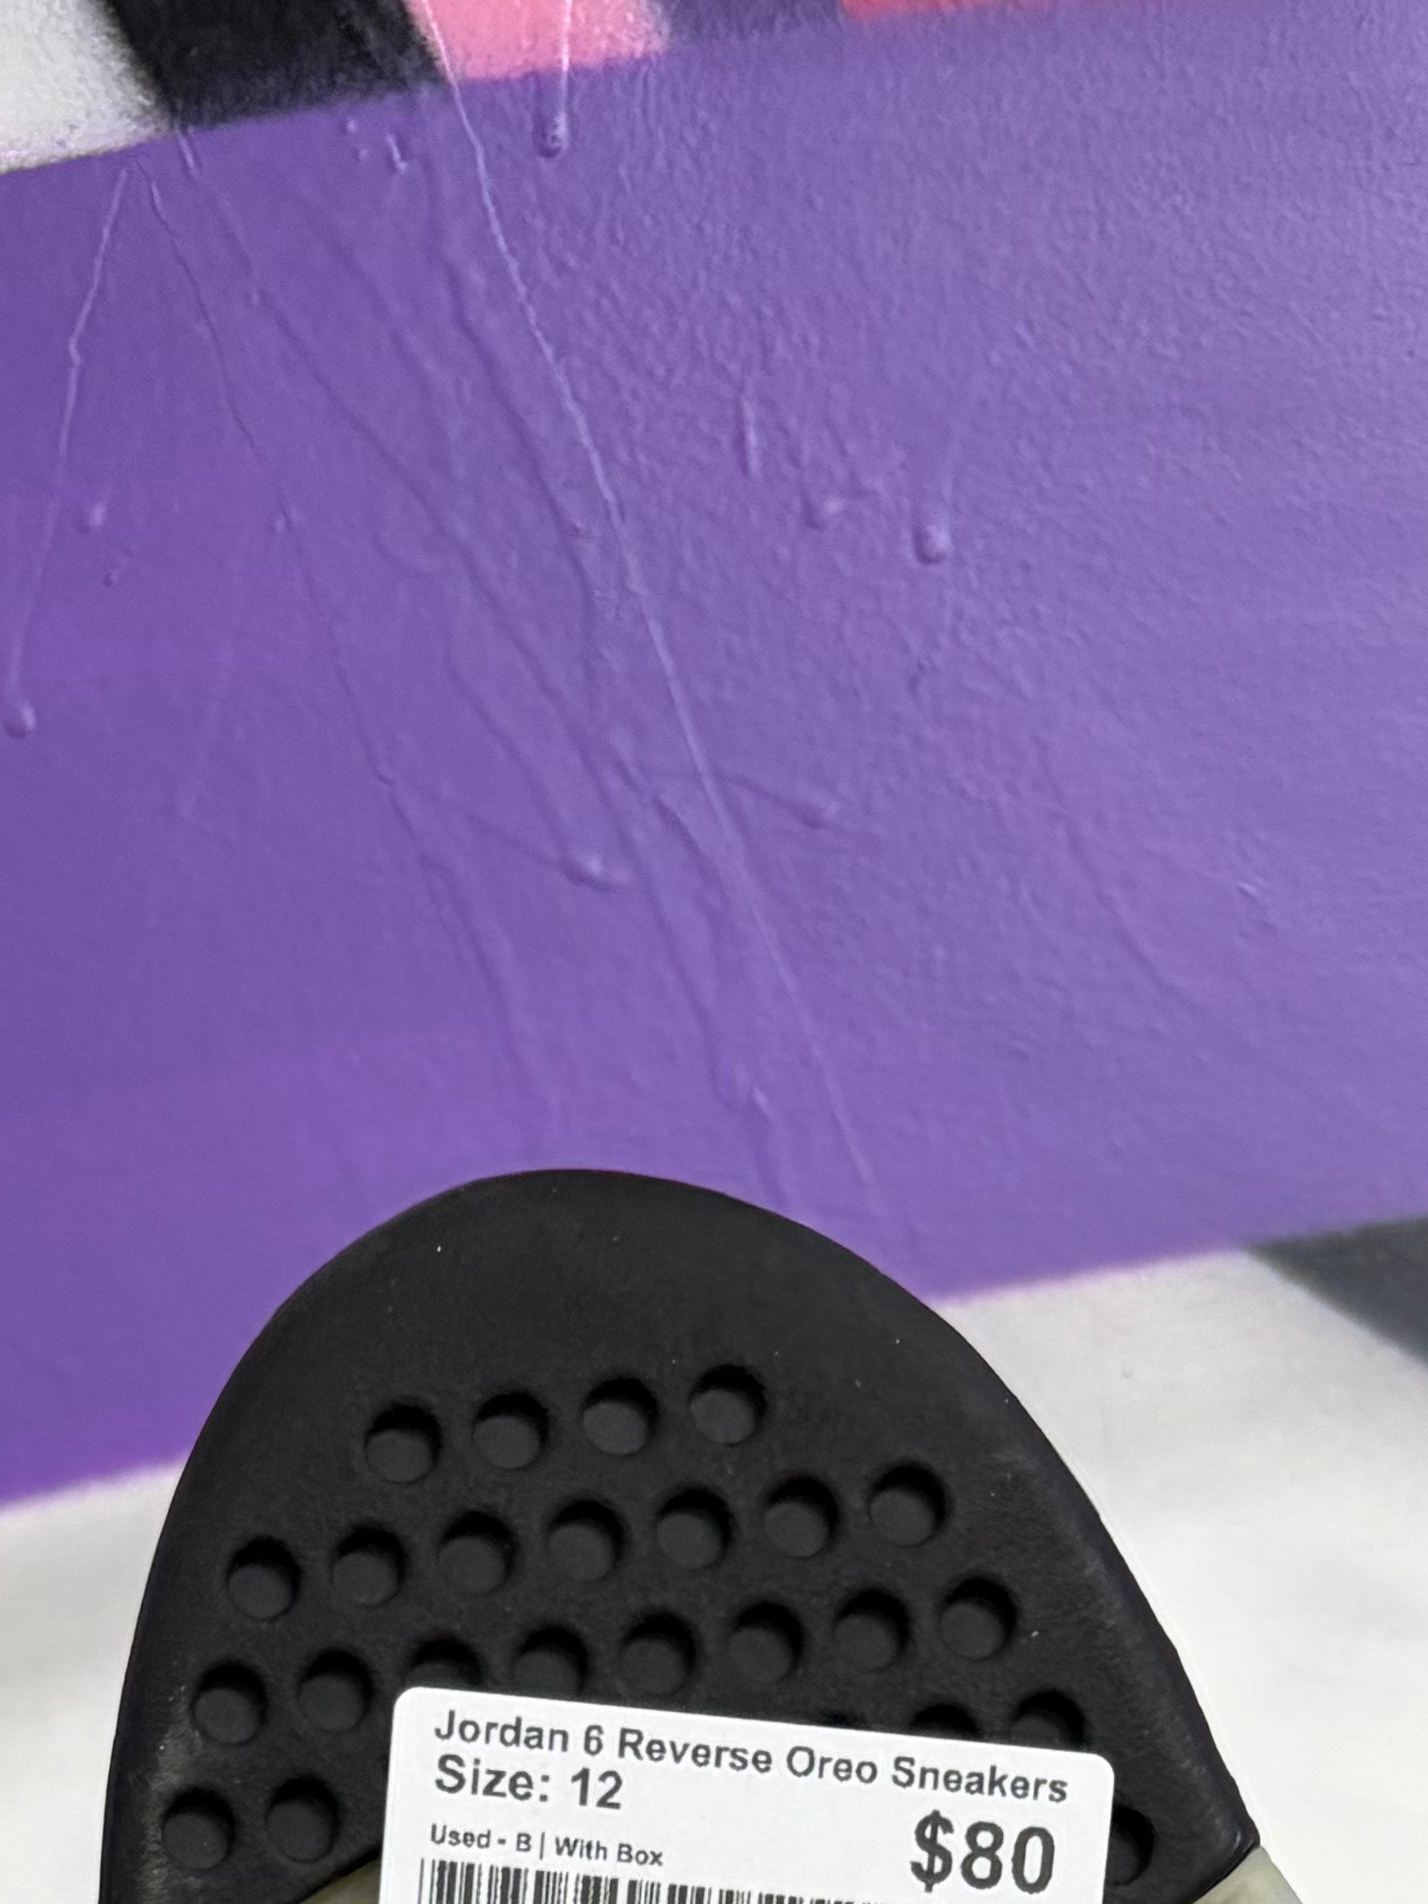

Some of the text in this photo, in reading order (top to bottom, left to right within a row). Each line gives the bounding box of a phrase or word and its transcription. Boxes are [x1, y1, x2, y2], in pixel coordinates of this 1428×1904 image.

[434, 1710, 1067, 1803] Jordan 6 Reverse Oreo Sneakers
[435, 1753, 624, 1810] Size: 12
[430, 1822, 491, 1849] Used
[516, 1832, 532, 1852] B
[555, 1836, 608, 1861] With
[617, 1843, 664, 1866] Box
[909, 1809, 1056, 1895] $80
